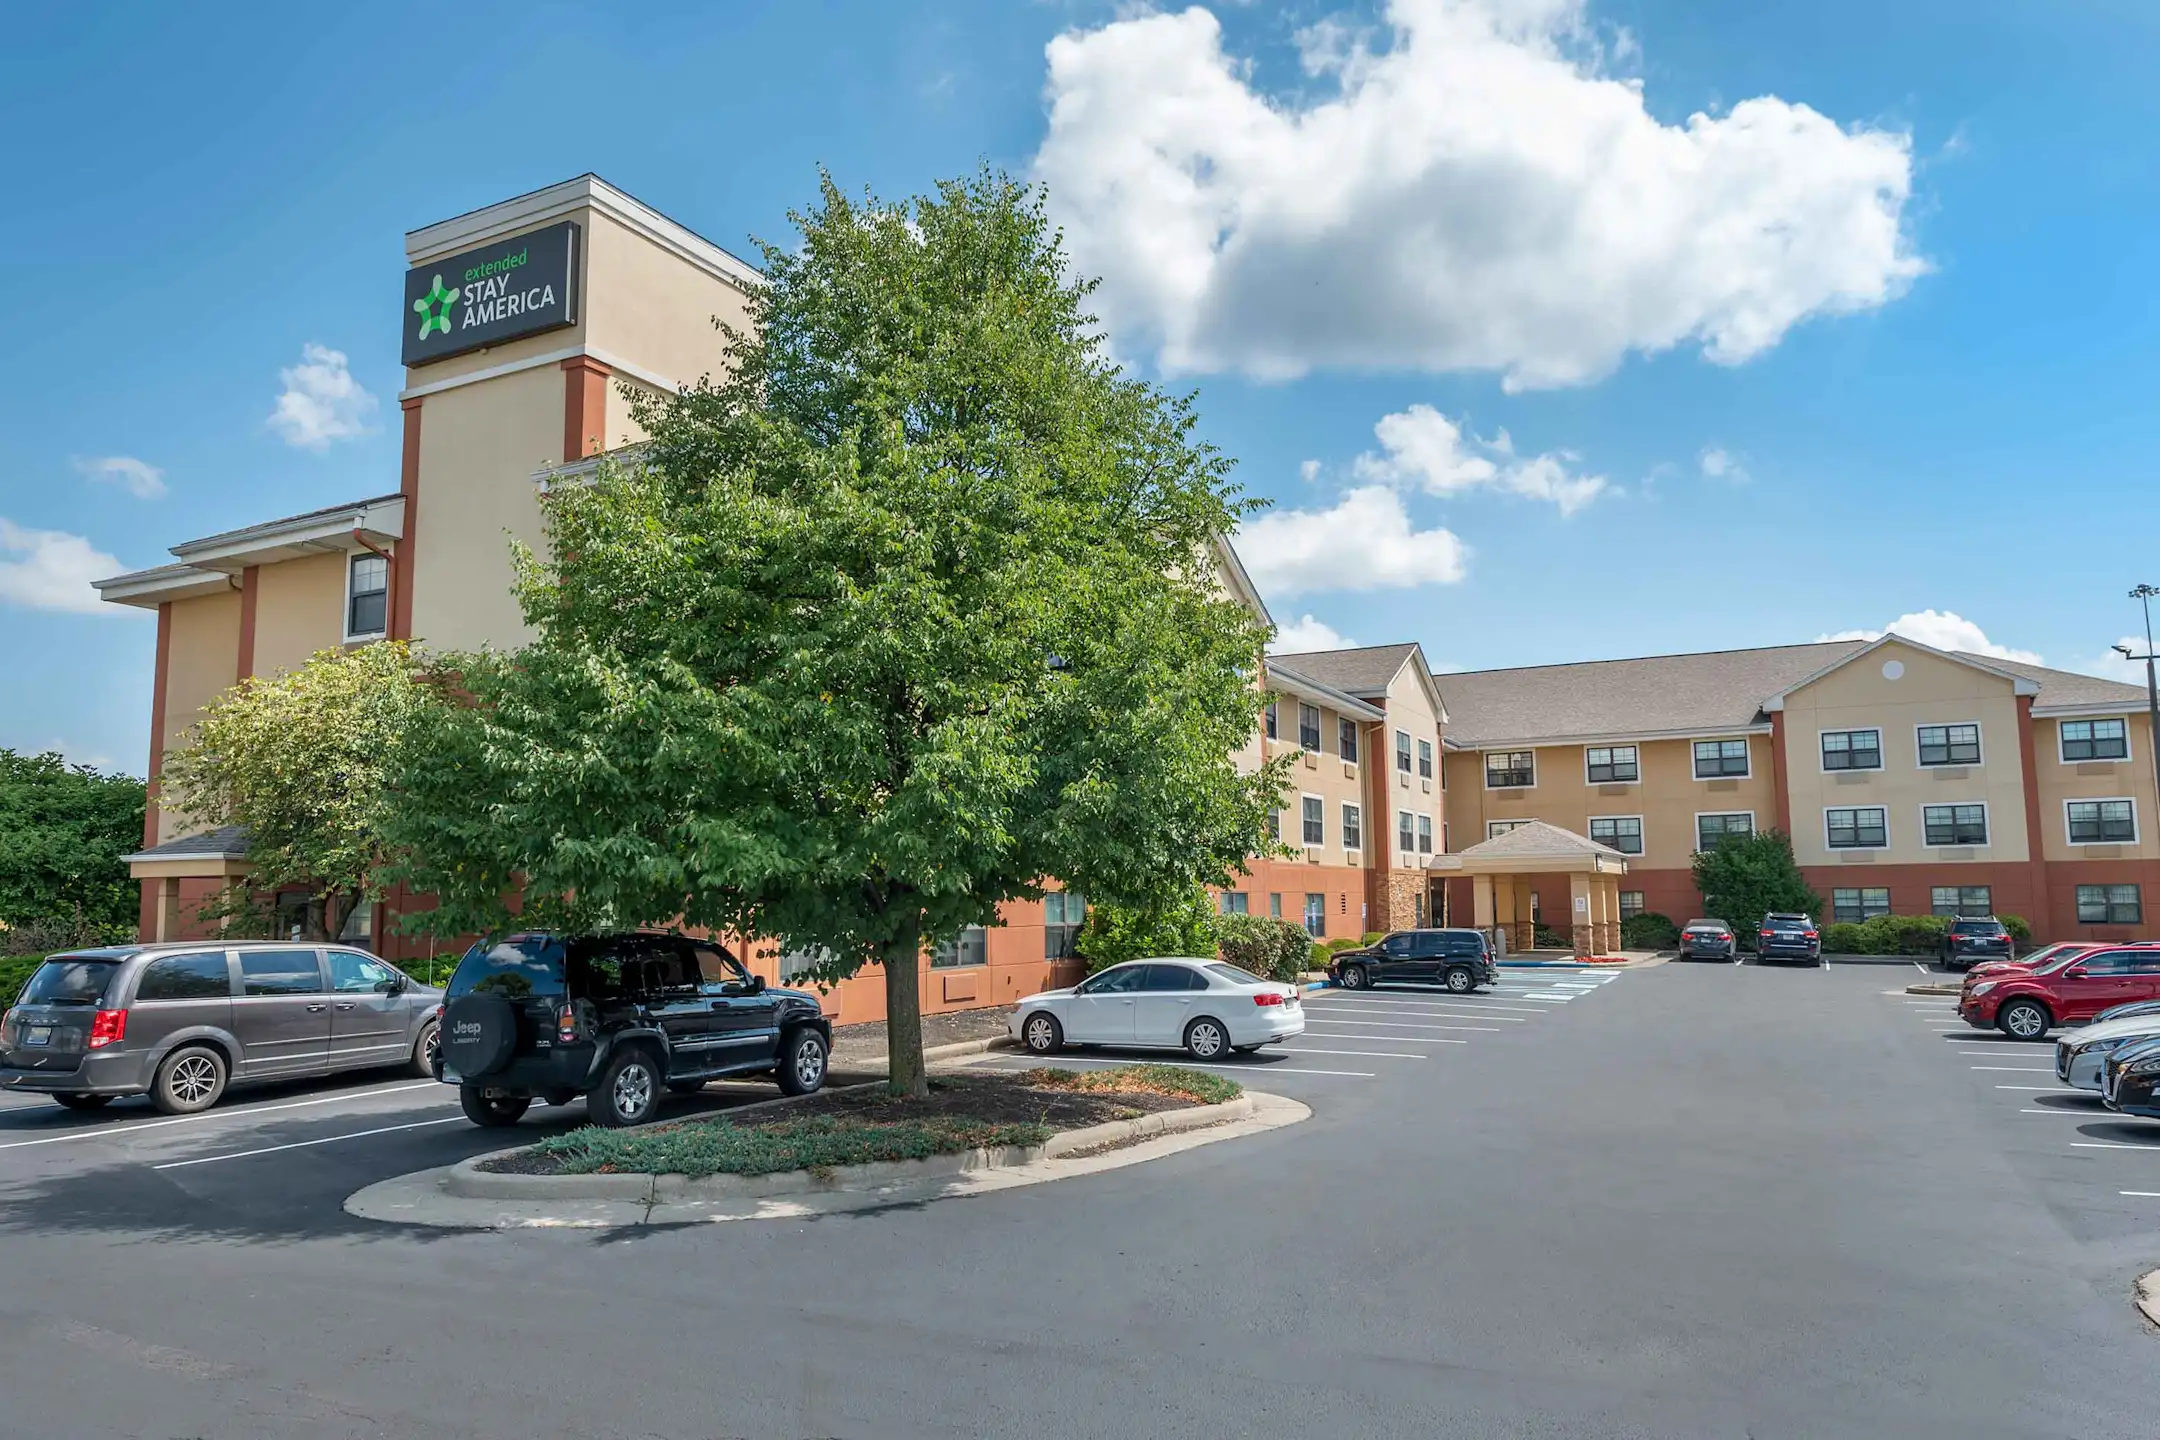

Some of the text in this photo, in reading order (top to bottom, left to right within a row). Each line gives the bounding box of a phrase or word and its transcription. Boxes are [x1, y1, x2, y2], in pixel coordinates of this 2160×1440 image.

[464, 248, 527, 281] extended
[463, 273, 511, 306] STAY
[462, 284, 555, 330] AMERICA
[452, 1019, 482, 1036] Jeep
